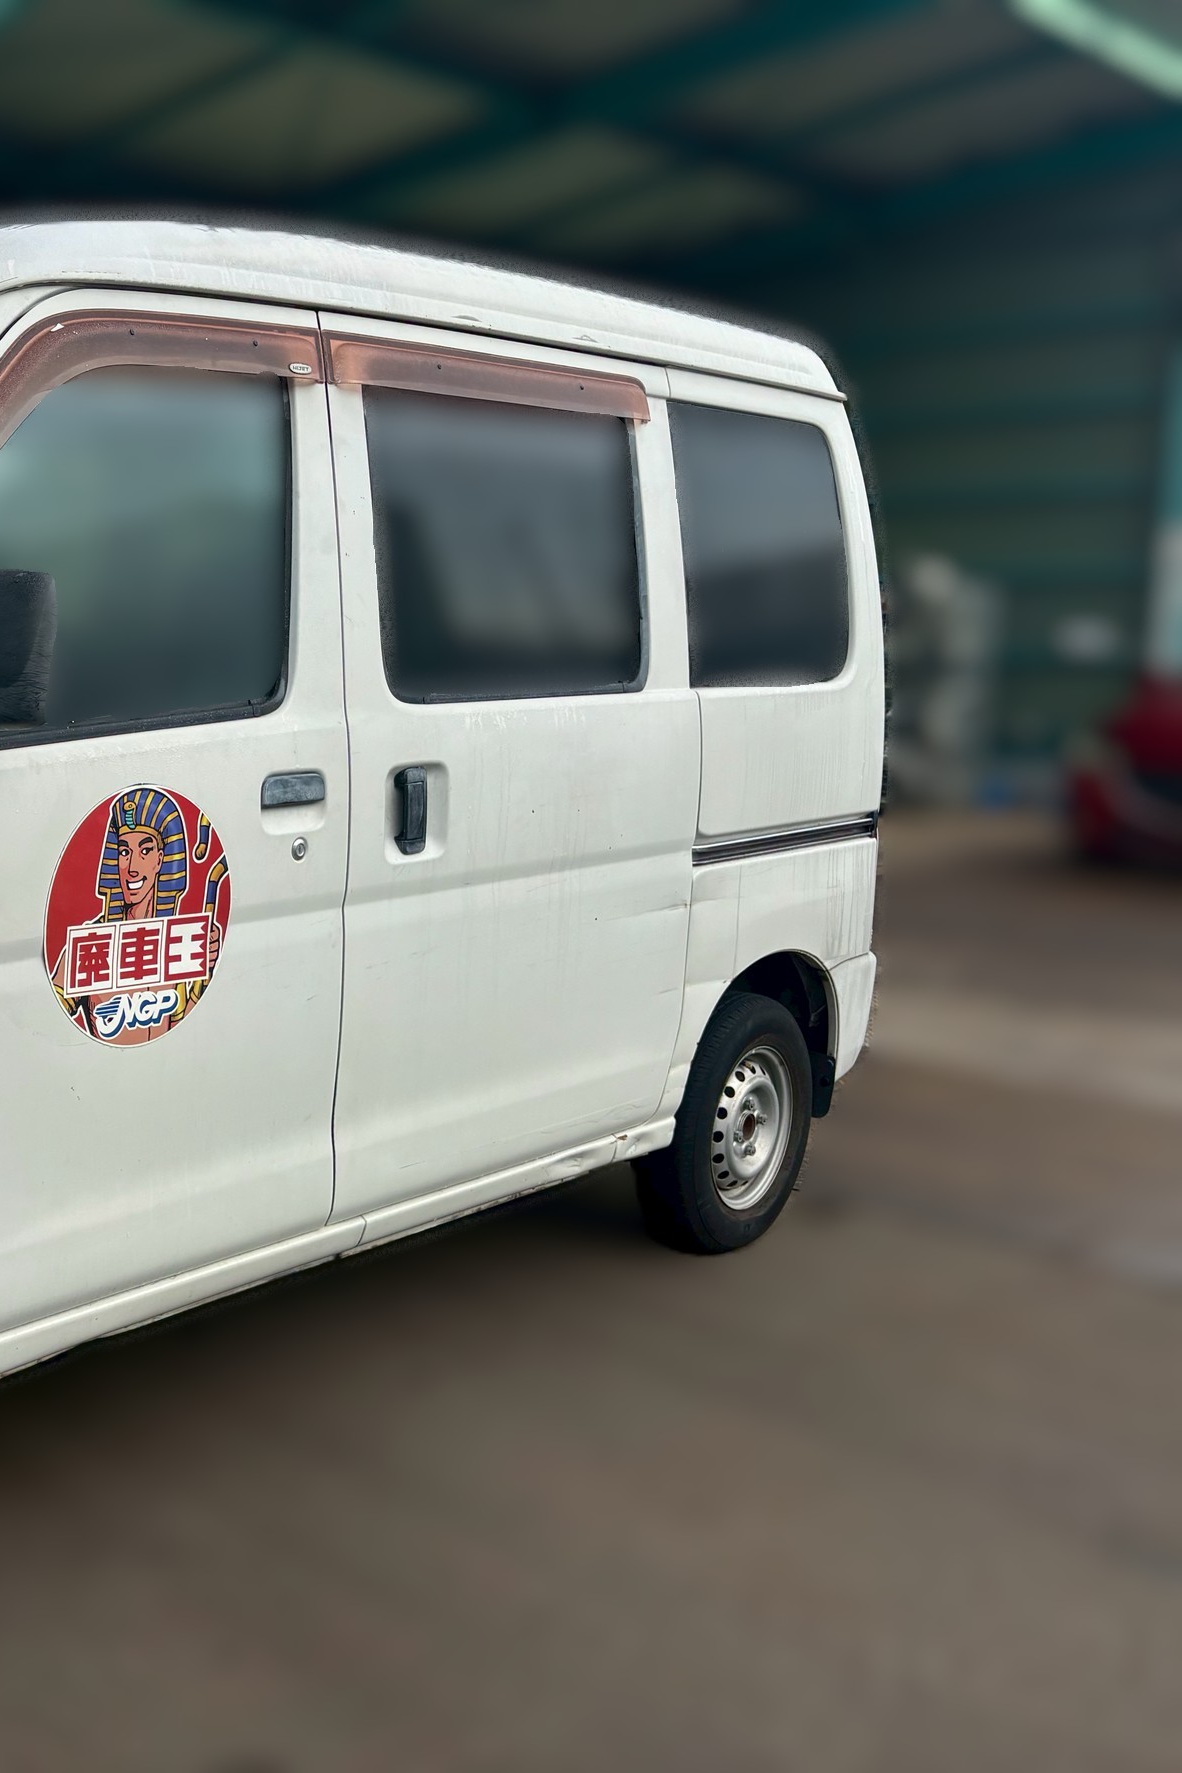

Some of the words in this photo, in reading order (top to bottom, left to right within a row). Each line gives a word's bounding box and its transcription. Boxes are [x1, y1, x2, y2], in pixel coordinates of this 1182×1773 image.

[69, 917, 207, 989] 廃車王
[95, 990, 178, 1038] NGP
